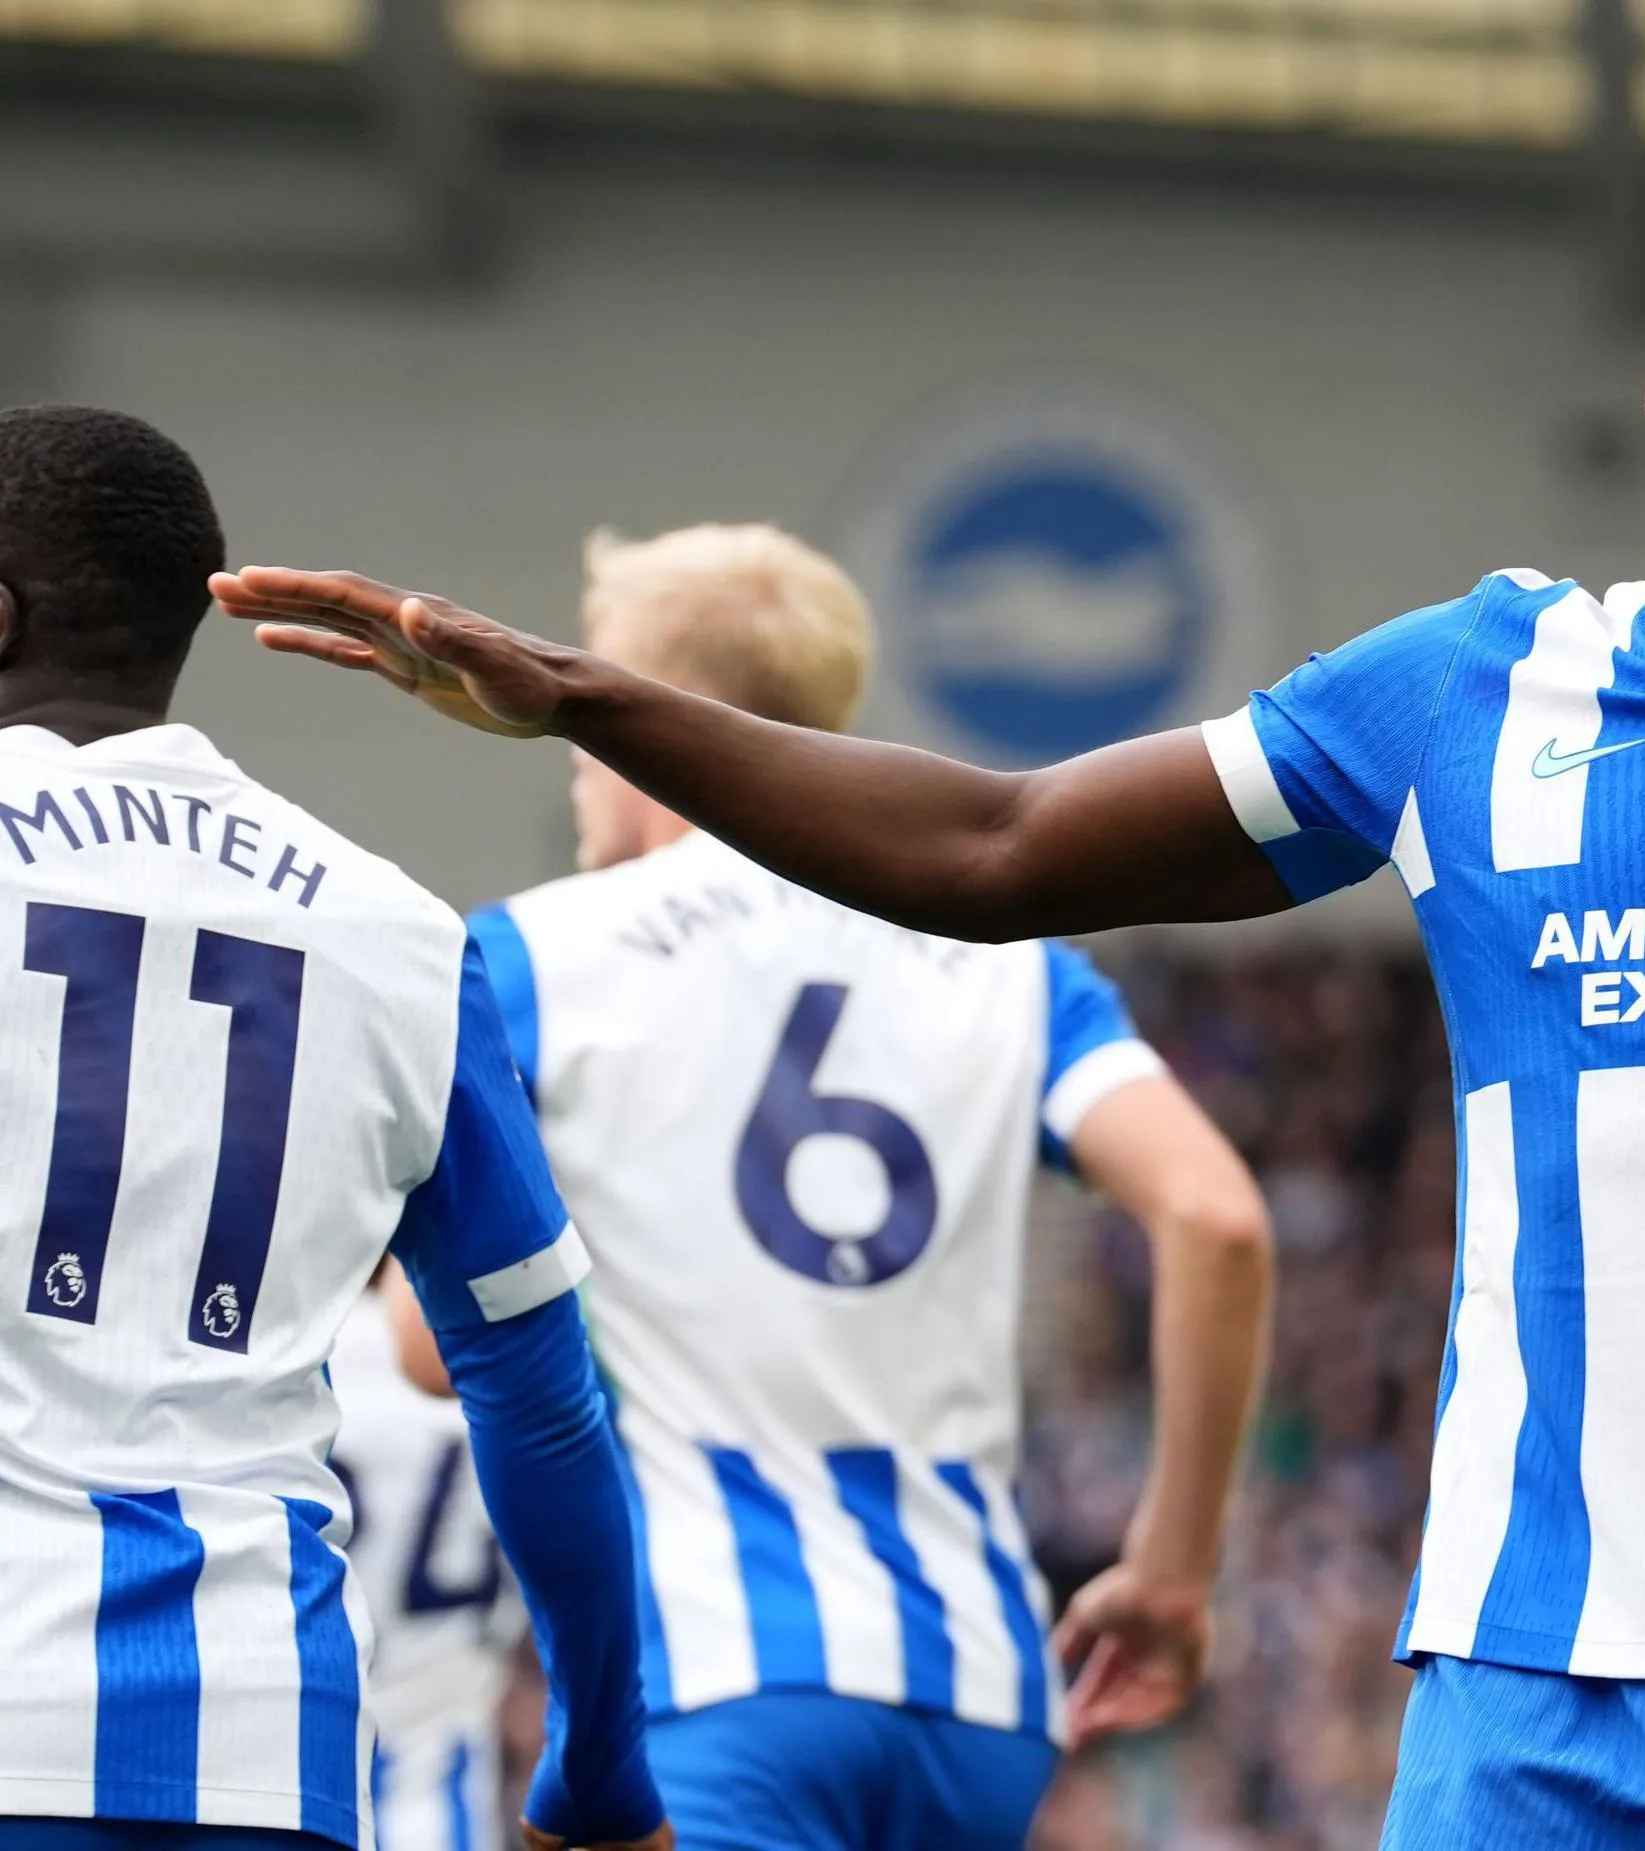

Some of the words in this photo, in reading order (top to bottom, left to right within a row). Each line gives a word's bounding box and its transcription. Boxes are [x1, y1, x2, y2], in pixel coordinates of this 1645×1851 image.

[0, 785, 328, 909] MINTEH
[23, 901, 306, 1355] 11
[732, 982, 939, 1289] 6
